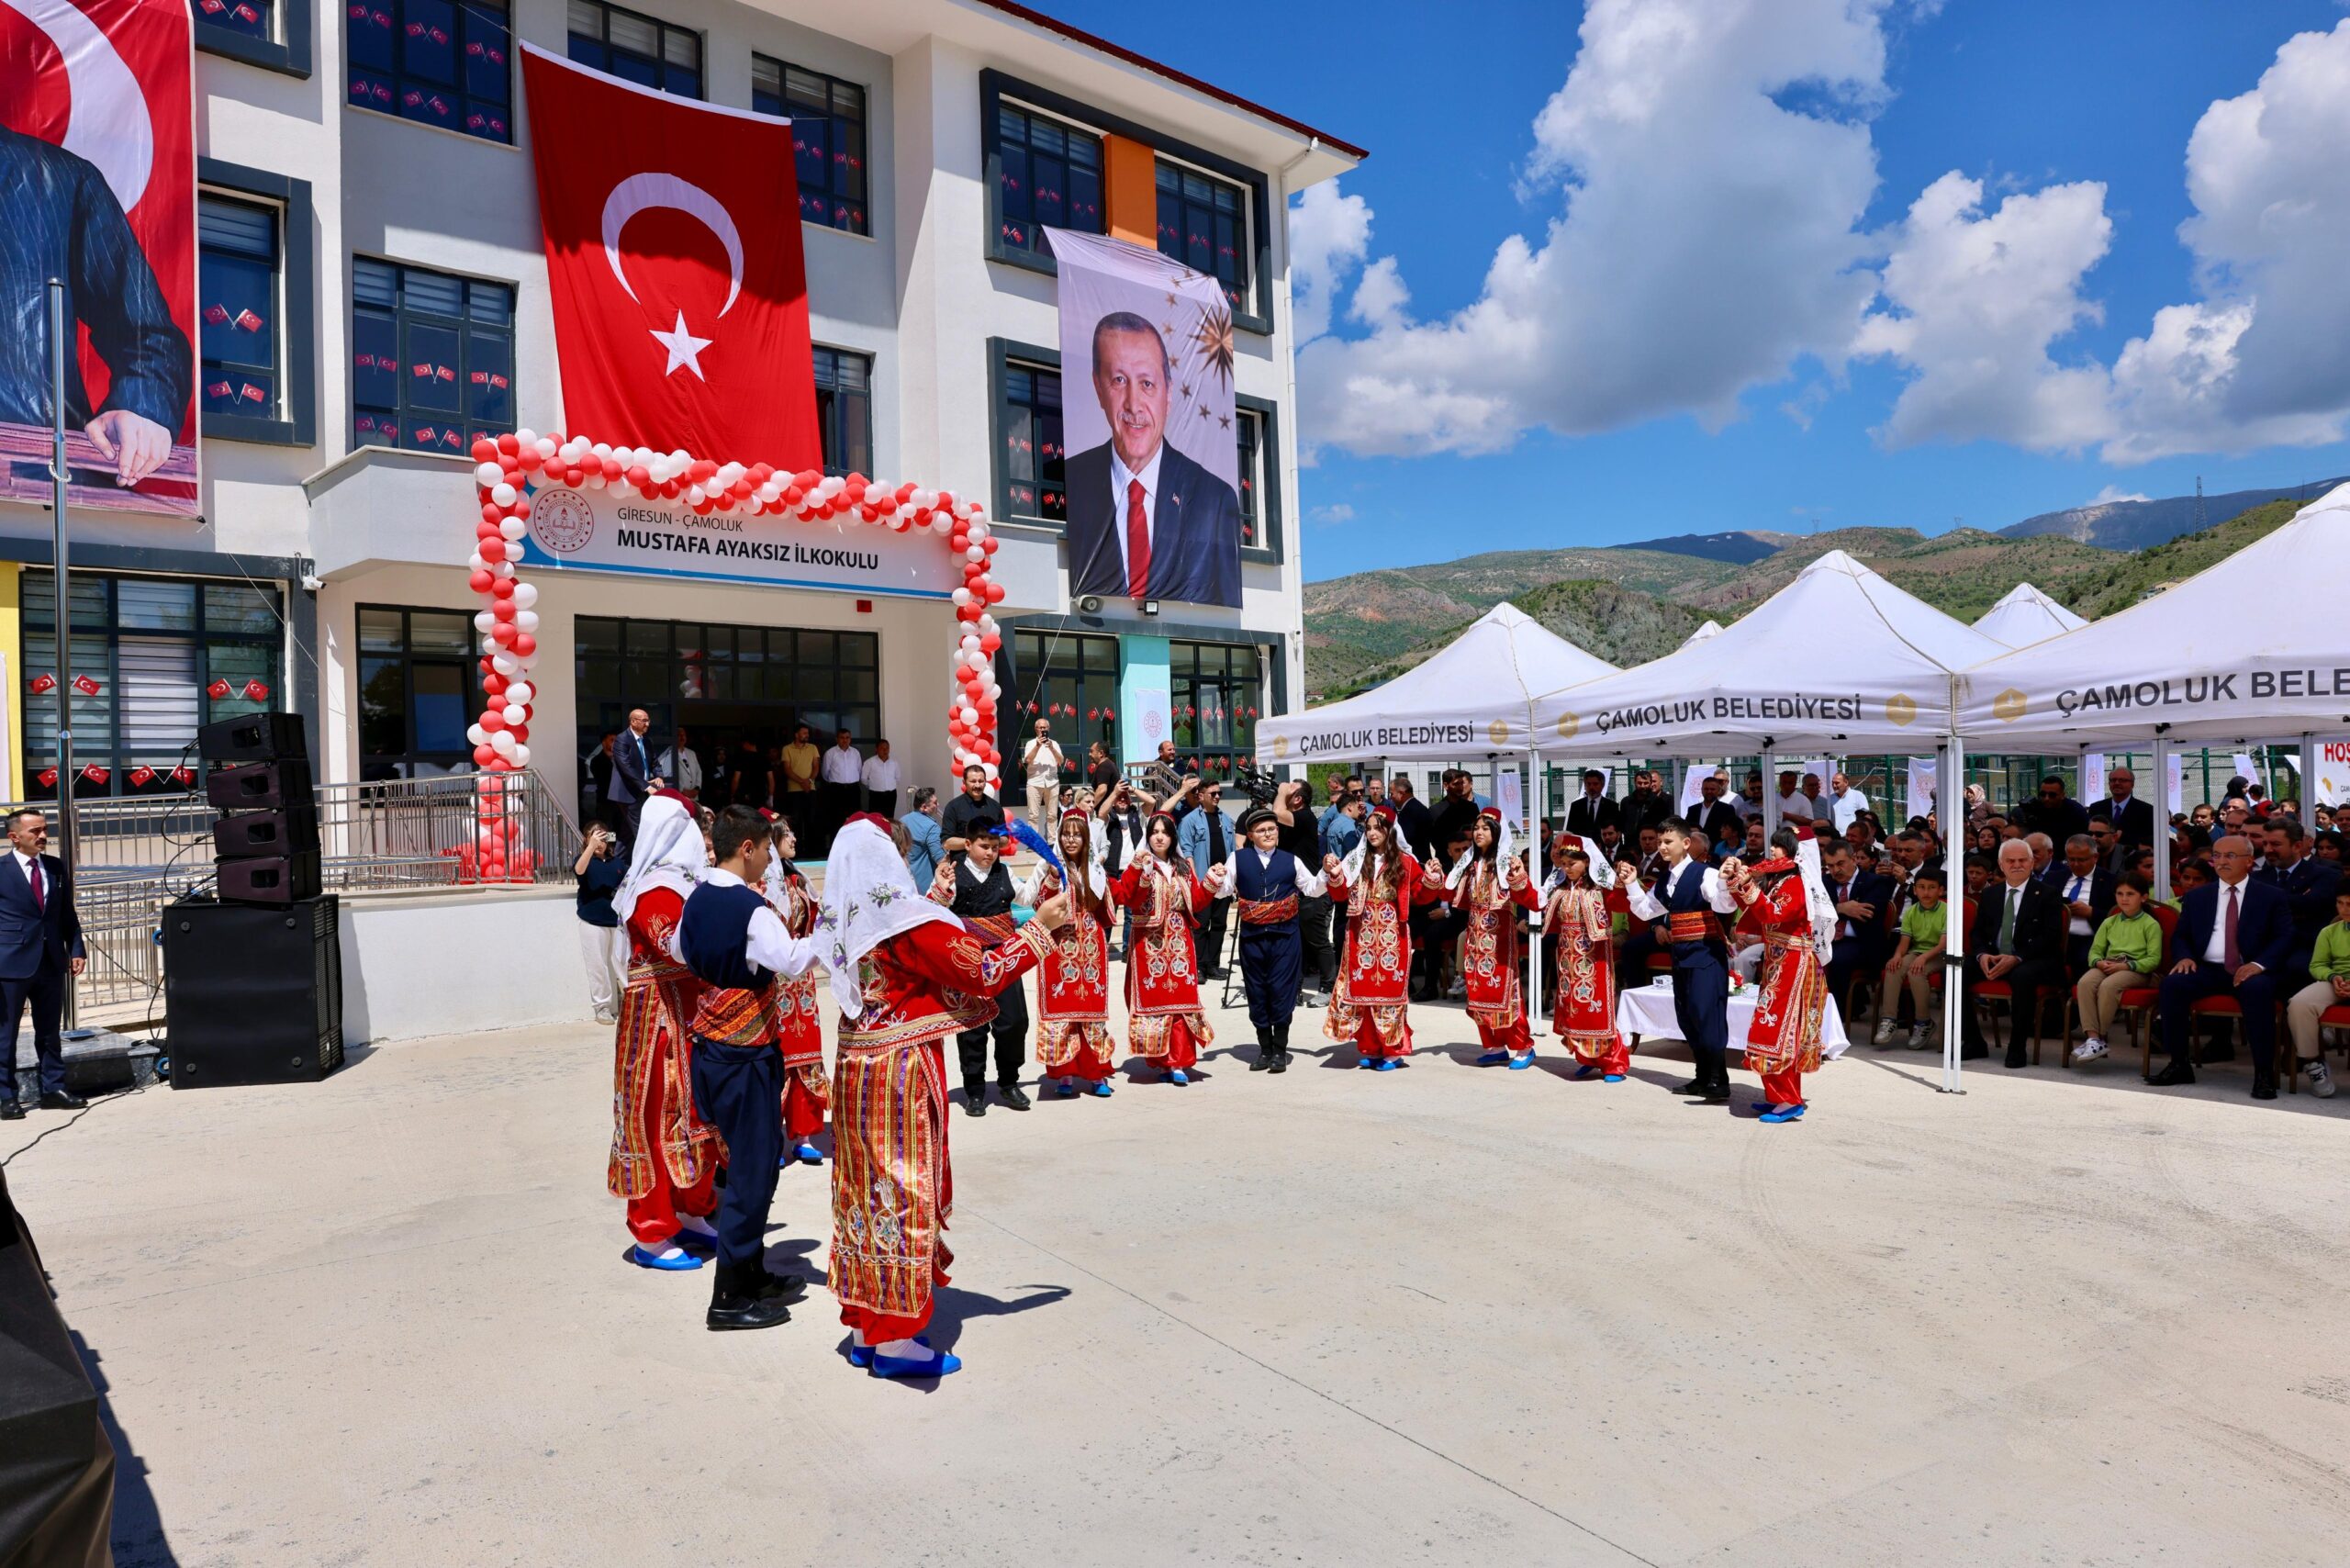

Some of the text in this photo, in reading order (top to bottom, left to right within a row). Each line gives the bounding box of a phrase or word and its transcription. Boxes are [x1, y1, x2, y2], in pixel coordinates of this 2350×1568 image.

[618, 506, 672, 525] GİRESUN
[683, 514, 743, 532] ÇAMOLUK
[617, 529, 878, 570] MUSTAFA AYAKSIZ İLKOKULU
[1596, 692, 1862, 735] ÇAMOLUK BELEDİYESİ
[2055, 668, 2350, 718] ÇAMOLUK BELE
[1300, 720, 1473, 756] ÇAMOLUK BELEDİYESİ
